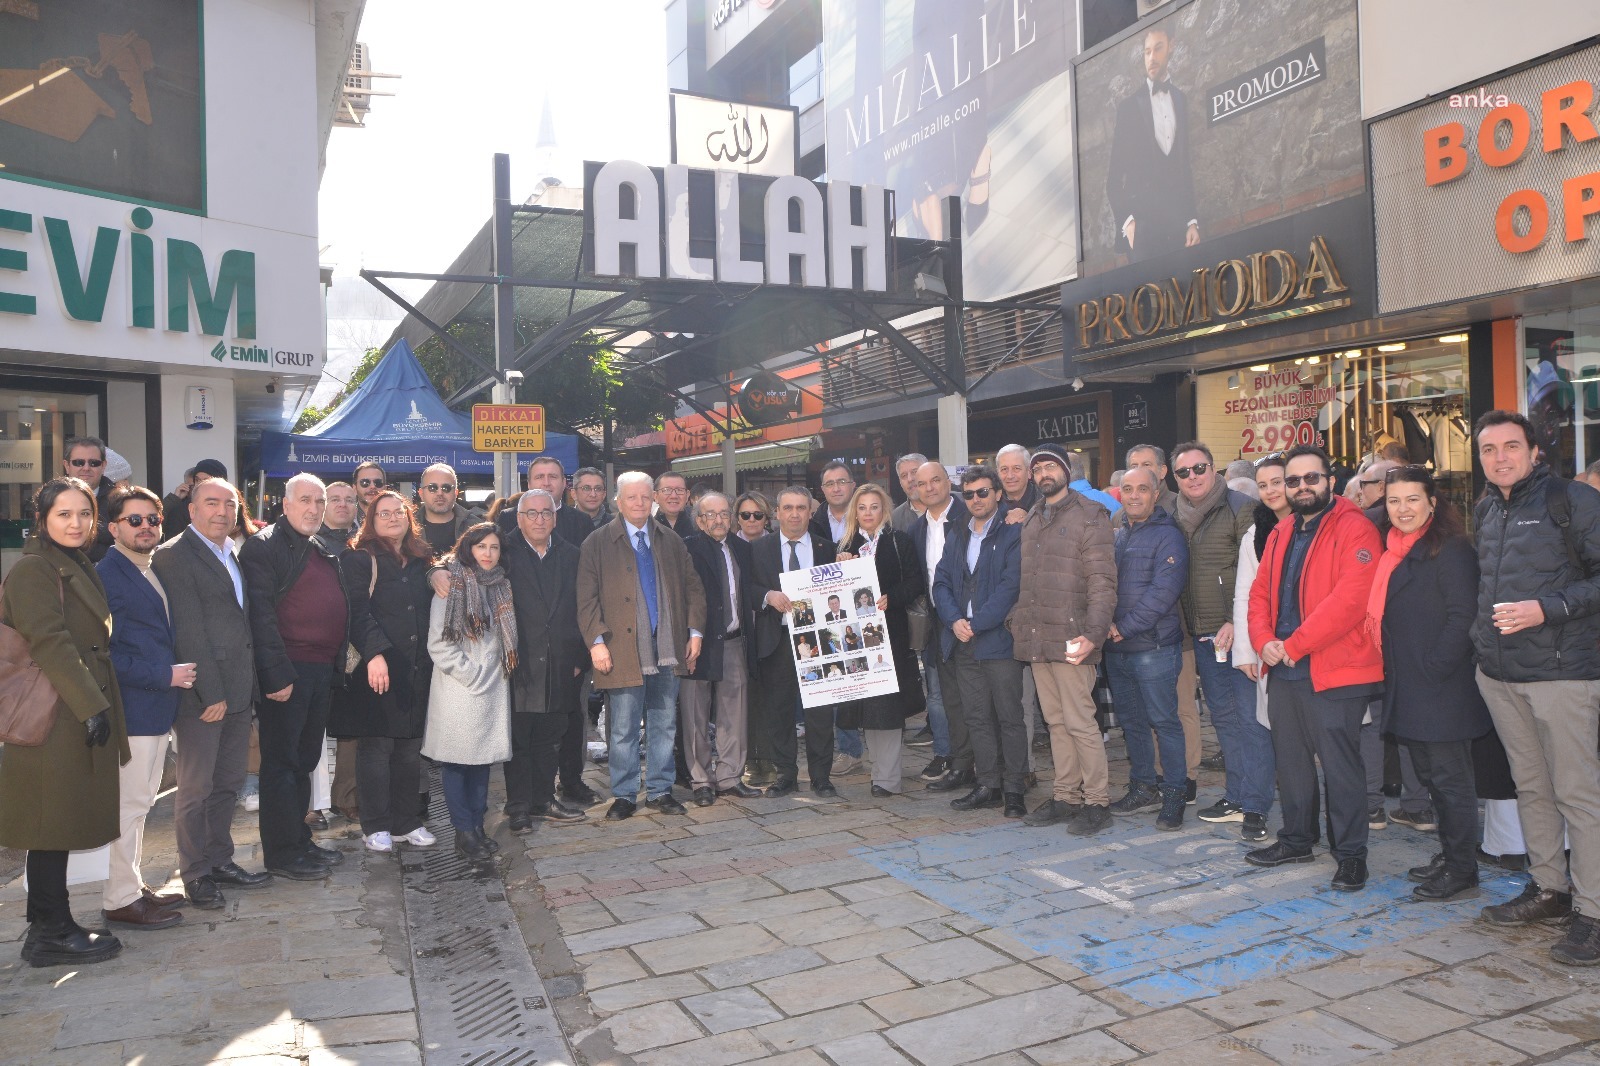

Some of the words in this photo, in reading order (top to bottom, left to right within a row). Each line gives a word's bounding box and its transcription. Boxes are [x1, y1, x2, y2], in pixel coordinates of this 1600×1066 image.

[844, 0, 1036, 156] MIZALLE
[1212, 52, 1320, 116] PROMODA
[883, 96, 981, 161] www.mizalle.com
[1495, 170, 1600, 254] OP
[593, 160, 887, 292] ALLAH
[1073, 235, 1348, 349] PROMODA
[231, 345, 268, 364] EMİN
[275, 351, 314, 367] GRUP
[1254, 368, 1302, 390] BÜYÜK
[480, 408, 537, 421] DİKKAT
[1225, 395, 1269, 414] SEZON
[1037, 412, 1098, 440] KATRE
[1245, 411, 1278, 424] TAKIM
[477, 424, 541, 435] HAREKETLİ
[484, 437, 535, 448] BARİYER
[302, 453, 330, 463] İZMİR
